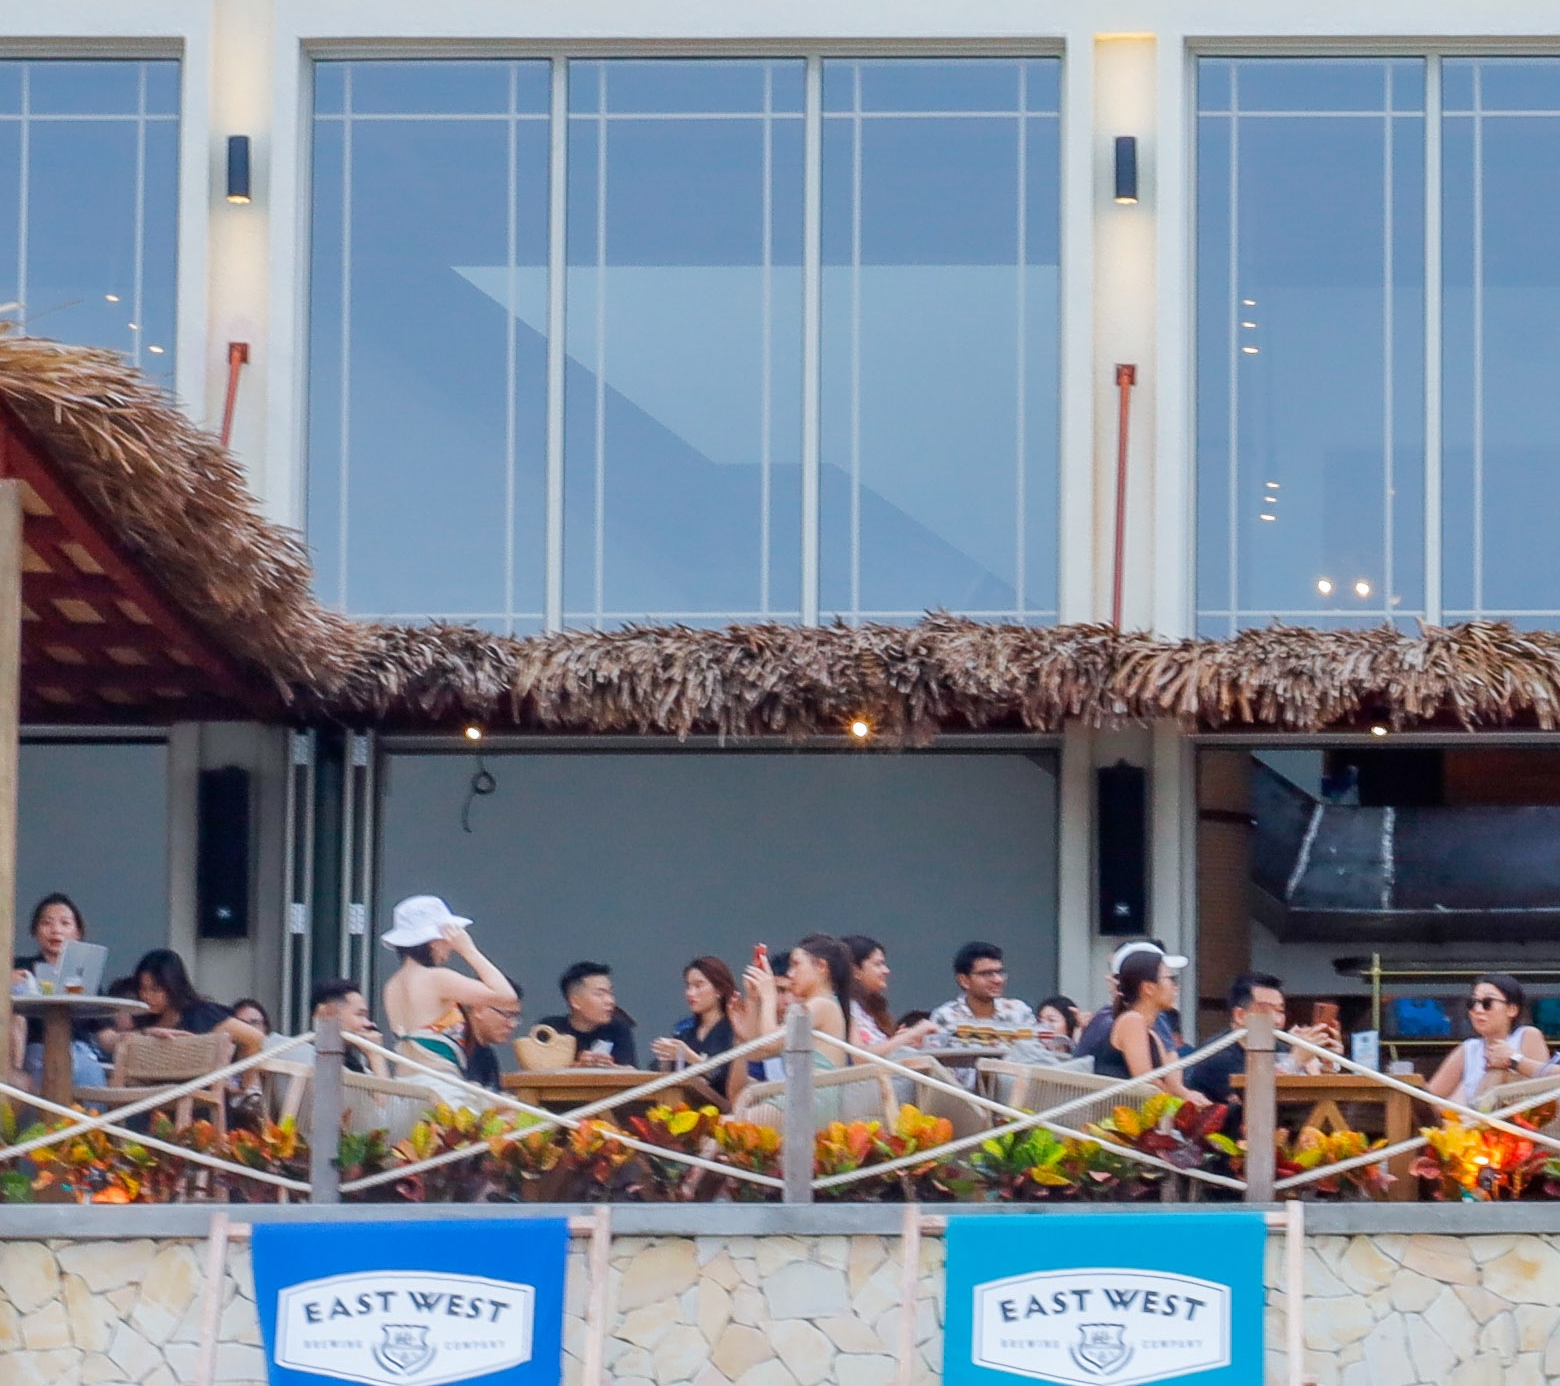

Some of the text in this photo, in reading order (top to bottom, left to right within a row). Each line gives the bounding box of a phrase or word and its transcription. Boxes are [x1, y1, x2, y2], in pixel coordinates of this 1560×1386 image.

[303, 1290, 510, 1325] EAST WEST
[998, 1286, 1208, 1324] EAST WEST
